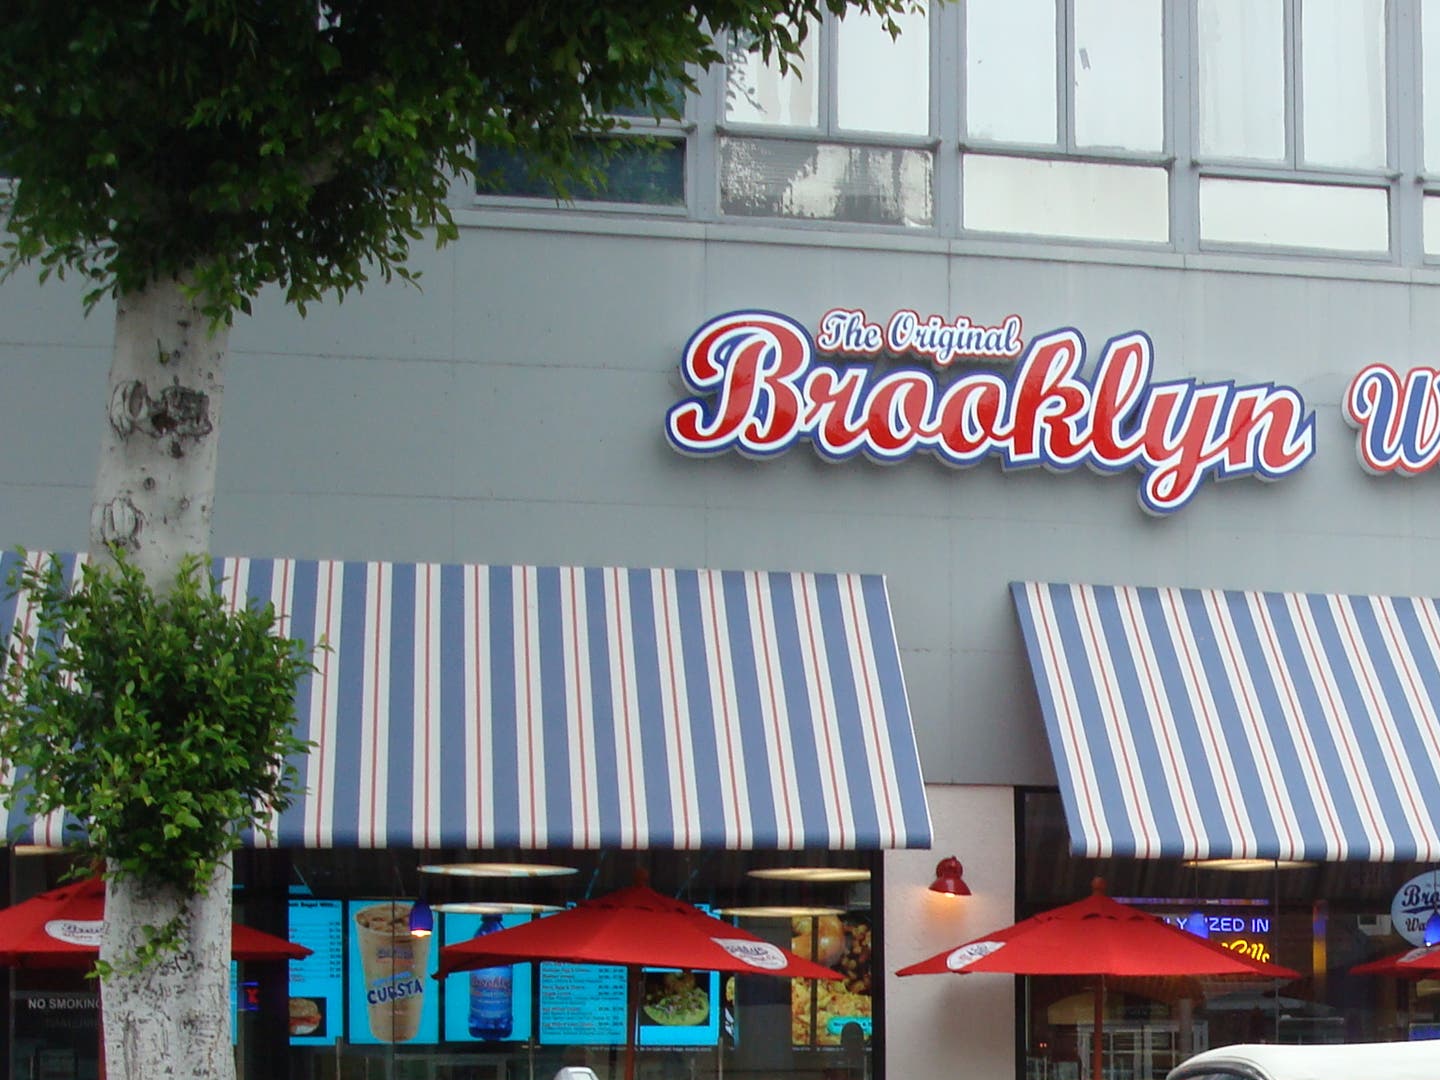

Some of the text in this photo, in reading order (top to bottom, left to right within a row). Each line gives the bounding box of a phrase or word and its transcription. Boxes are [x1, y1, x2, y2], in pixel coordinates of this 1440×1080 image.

[820, 309, 1023, 364] The Original
[666, 310, 1317, 516] Brooklyn
[1251, 919, 1269, 932] IN
[28, 999, 46, 1010] NO
